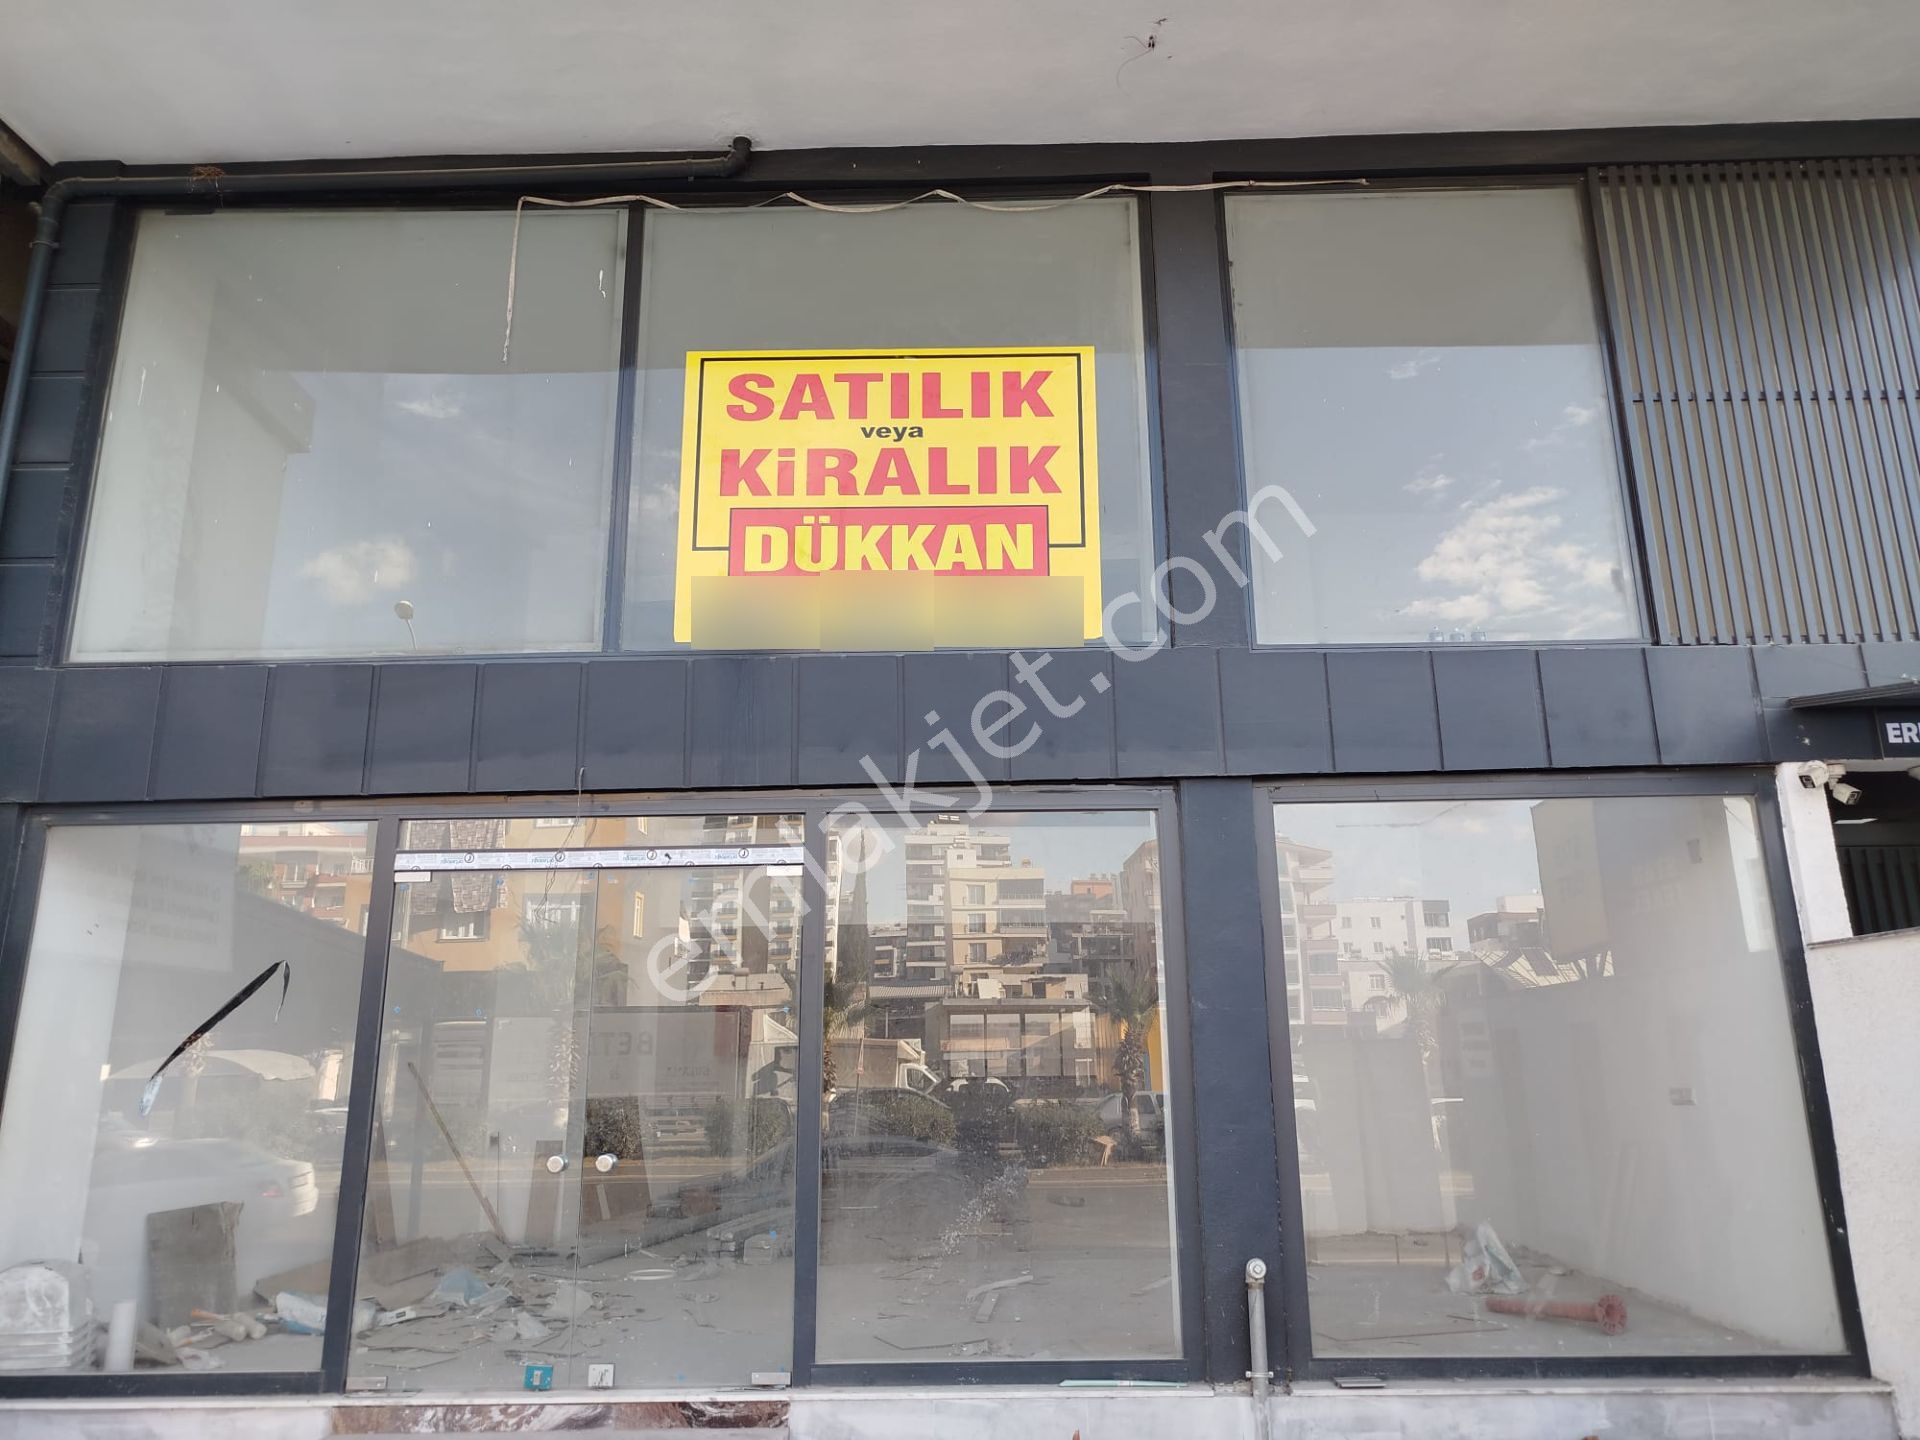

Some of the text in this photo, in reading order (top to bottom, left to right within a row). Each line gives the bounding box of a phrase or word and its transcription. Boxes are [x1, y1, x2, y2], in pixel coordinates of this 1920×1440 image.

[726, 370, 1055, 421] SATILIK
[860, 424, 924, 442] veya
[743, 515, 1034, 573] DÜKKAN
[1885, 722, 1920, 744] ER
